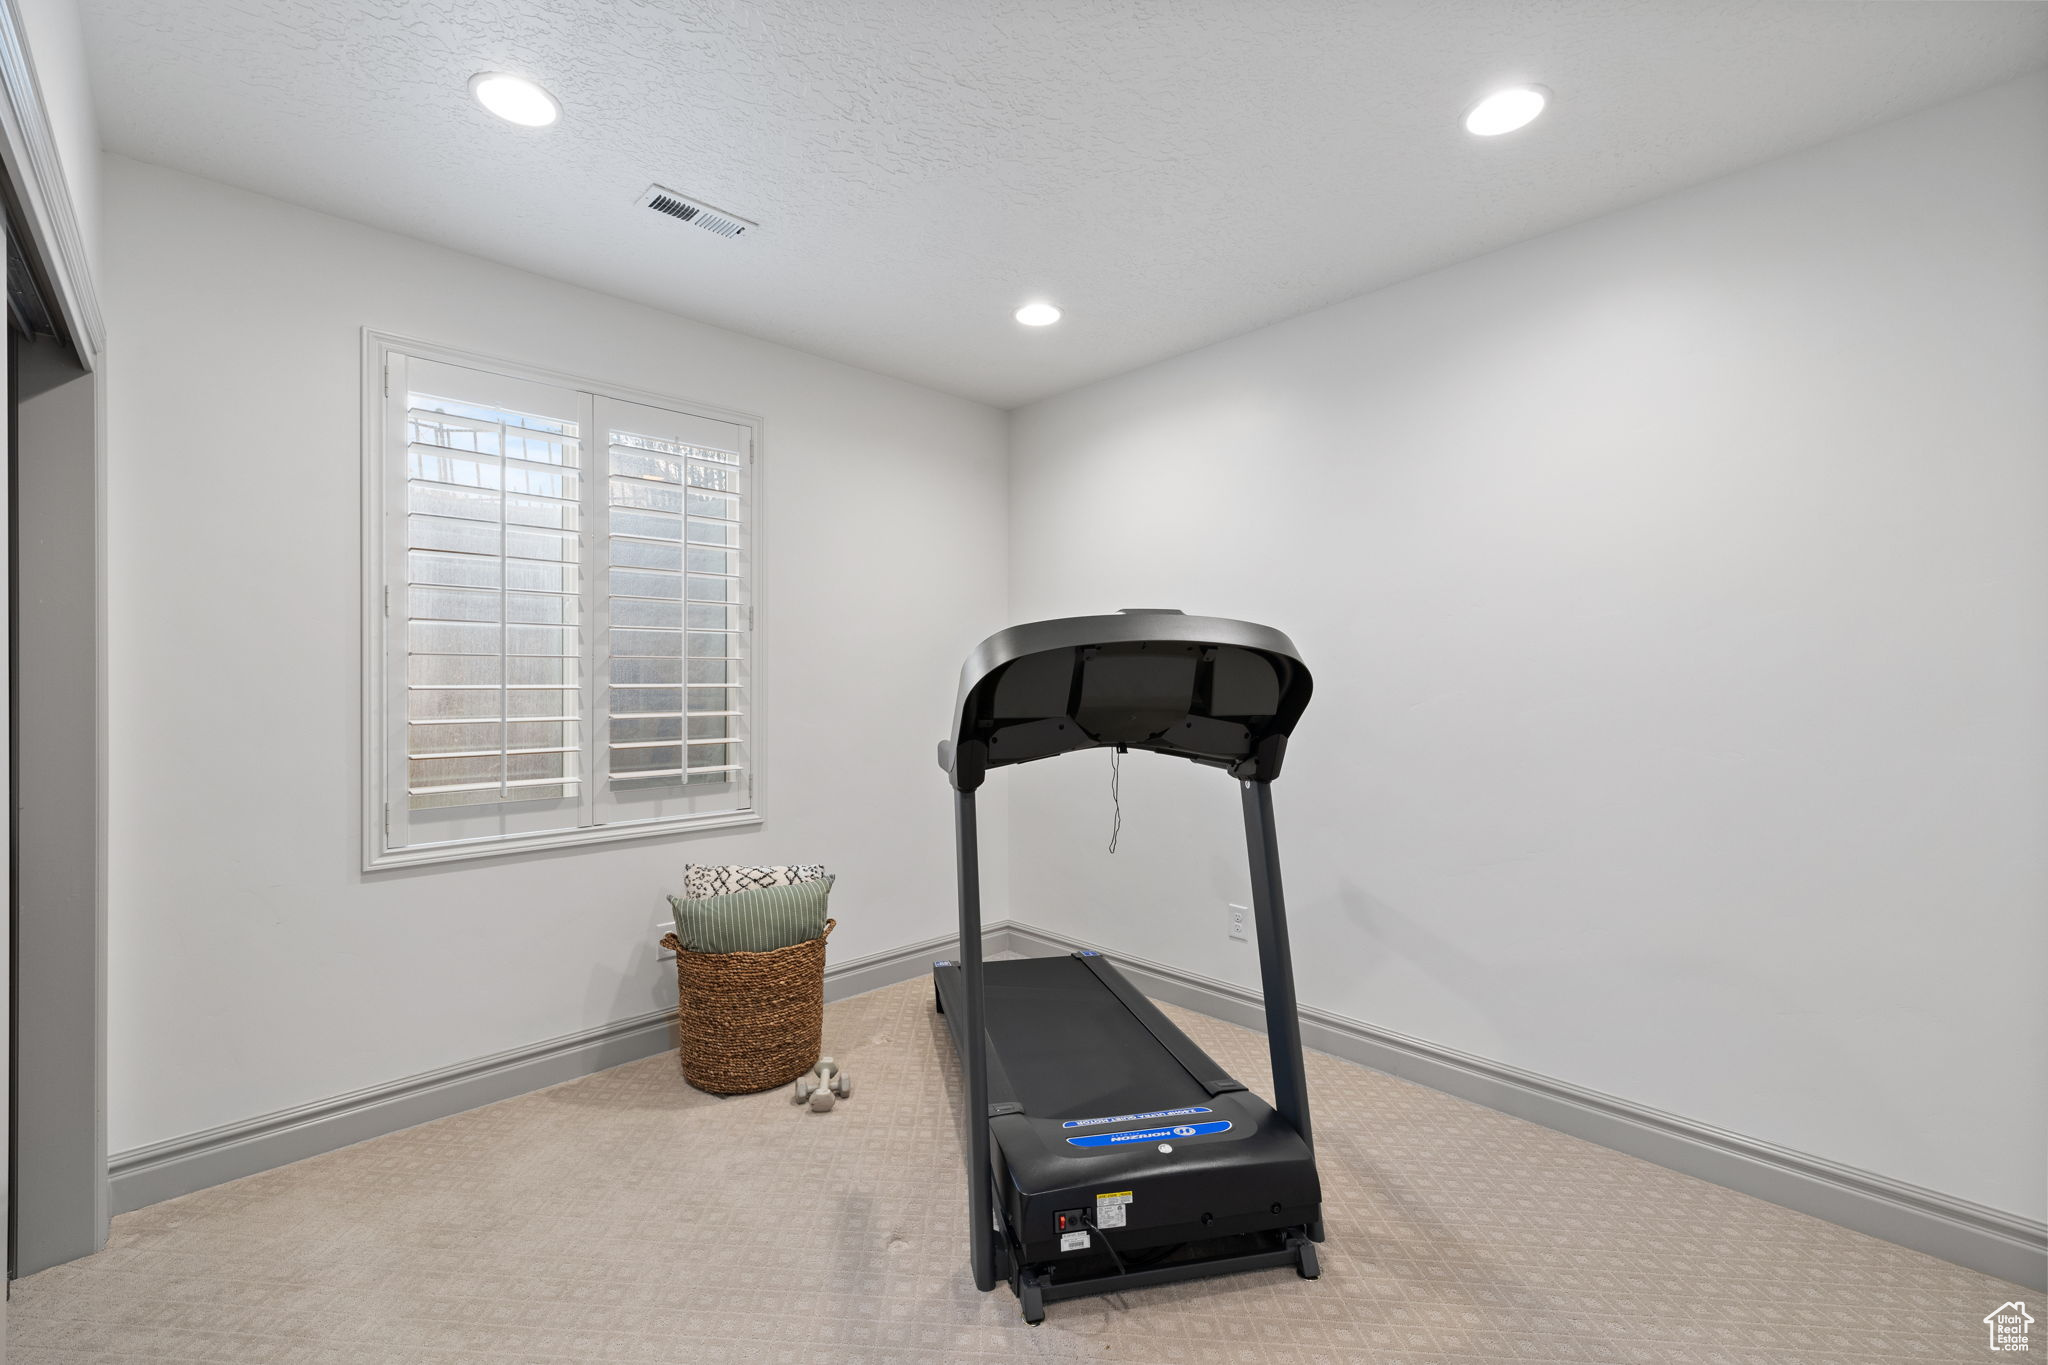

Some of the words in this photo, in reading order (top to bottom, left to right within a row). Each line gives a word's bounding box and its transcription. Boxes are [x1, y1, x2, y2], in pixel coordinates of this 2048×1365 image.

[1138, 1111, 1166, 1119] ULTRA
[1077, 1117, 1108, 1125] MOTOR
[1111, 1131, 1171, 1142] HORIZON
